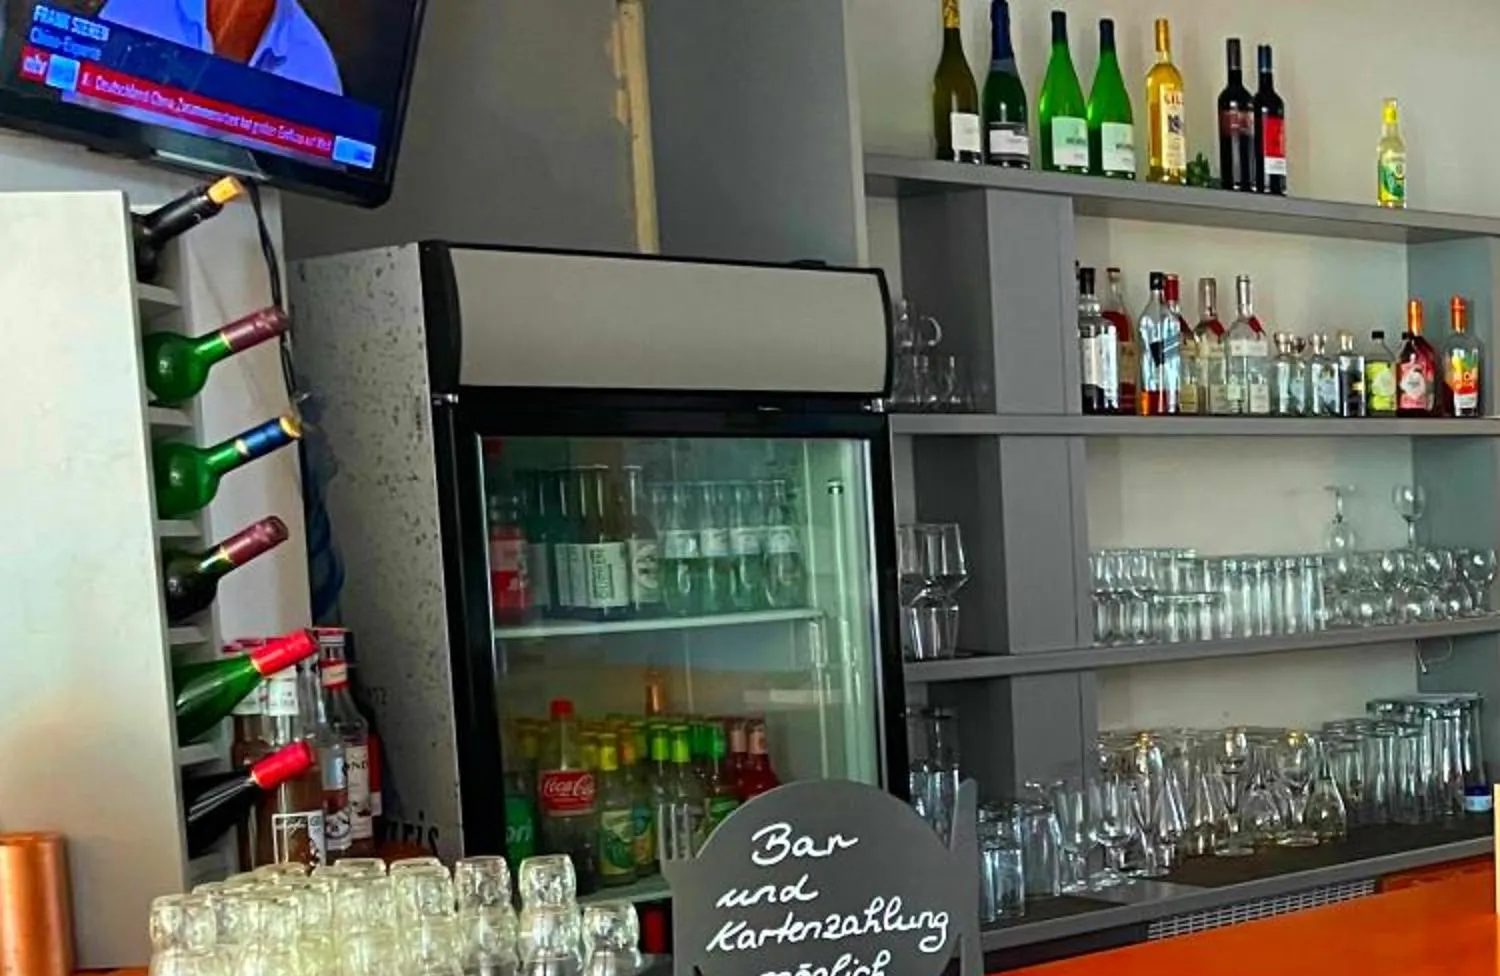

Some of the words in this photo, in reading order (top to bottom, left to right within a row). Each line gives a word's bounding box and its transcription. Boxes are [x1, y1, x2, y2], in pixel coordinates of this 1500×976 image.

[751, 822, 859, 866] Bar
[715, 873, 819, 908] und
[705, 895, 950, 953] Kartenzahlung
